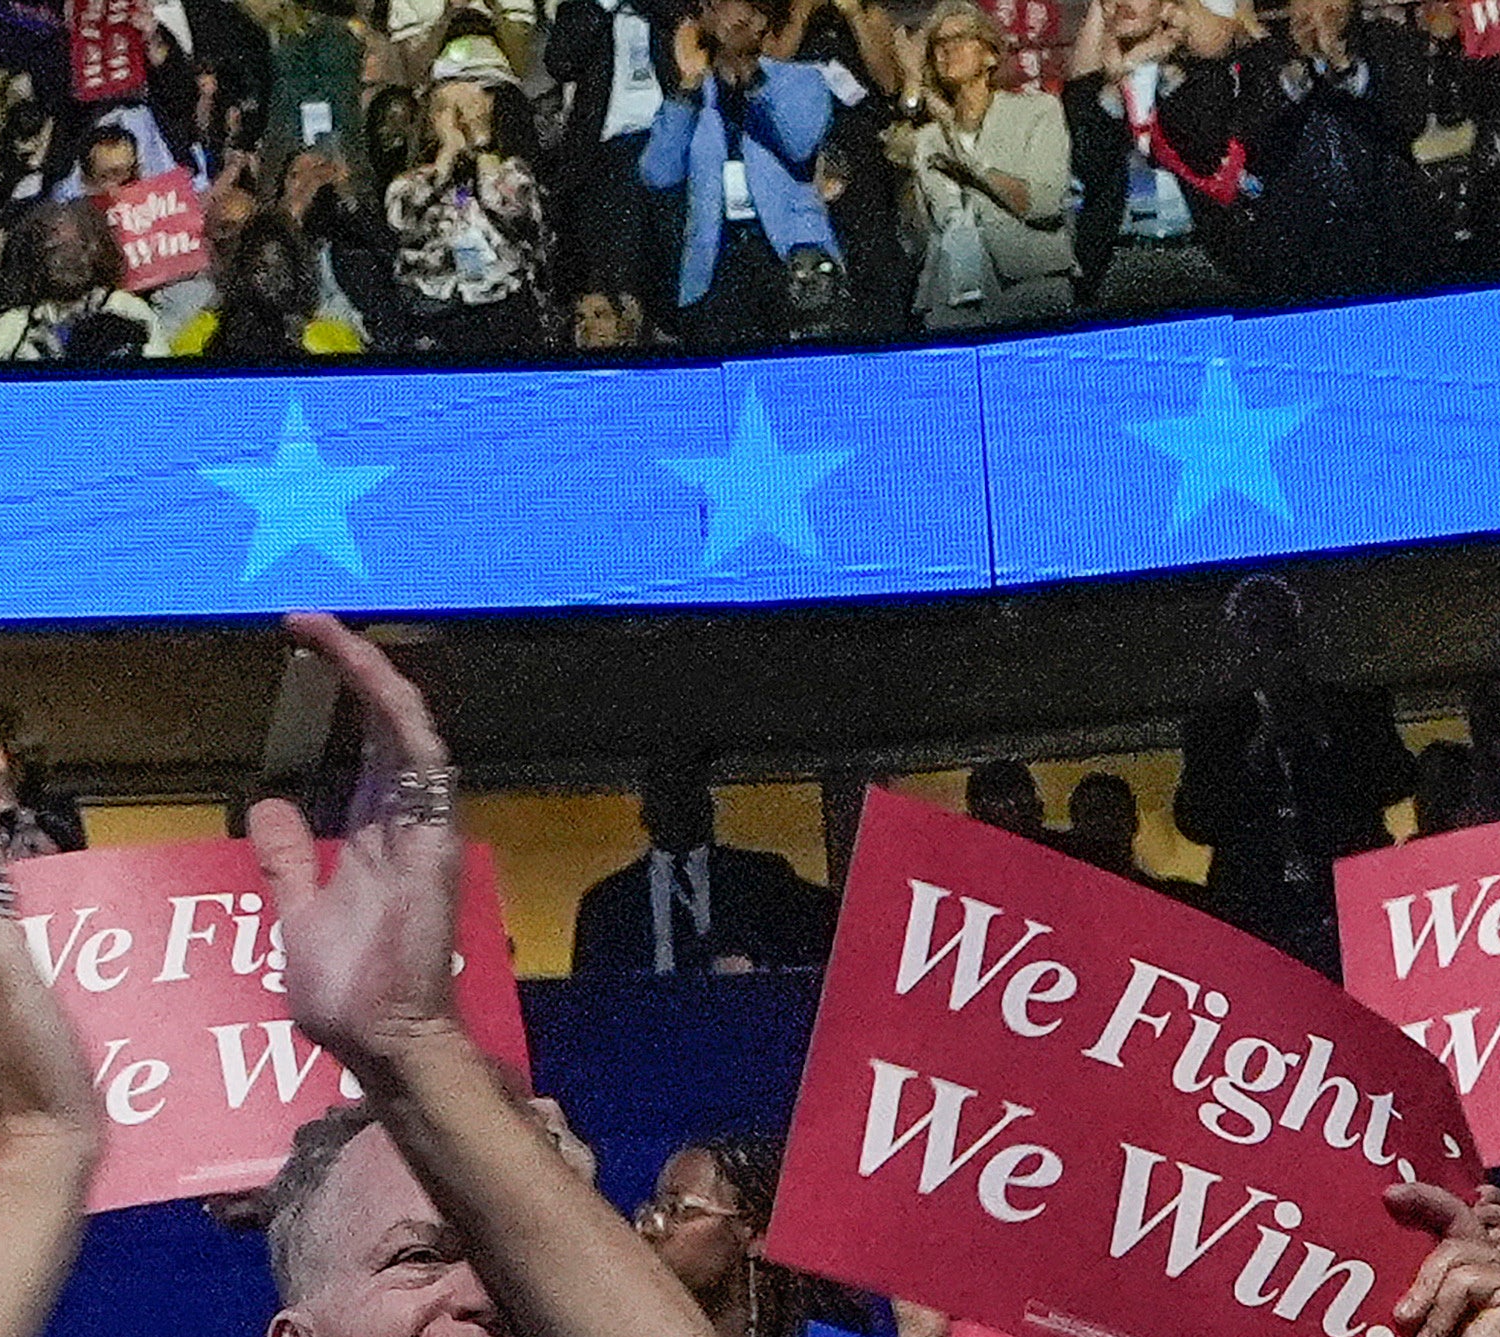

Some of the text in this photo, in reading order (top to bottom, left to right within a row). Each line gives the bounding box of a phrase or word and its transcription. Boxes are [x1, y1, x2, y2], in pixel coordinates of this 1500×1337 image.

[858, 1057, 1065, 1223] We
[894, 877, 1417, 1184] We Fight,
